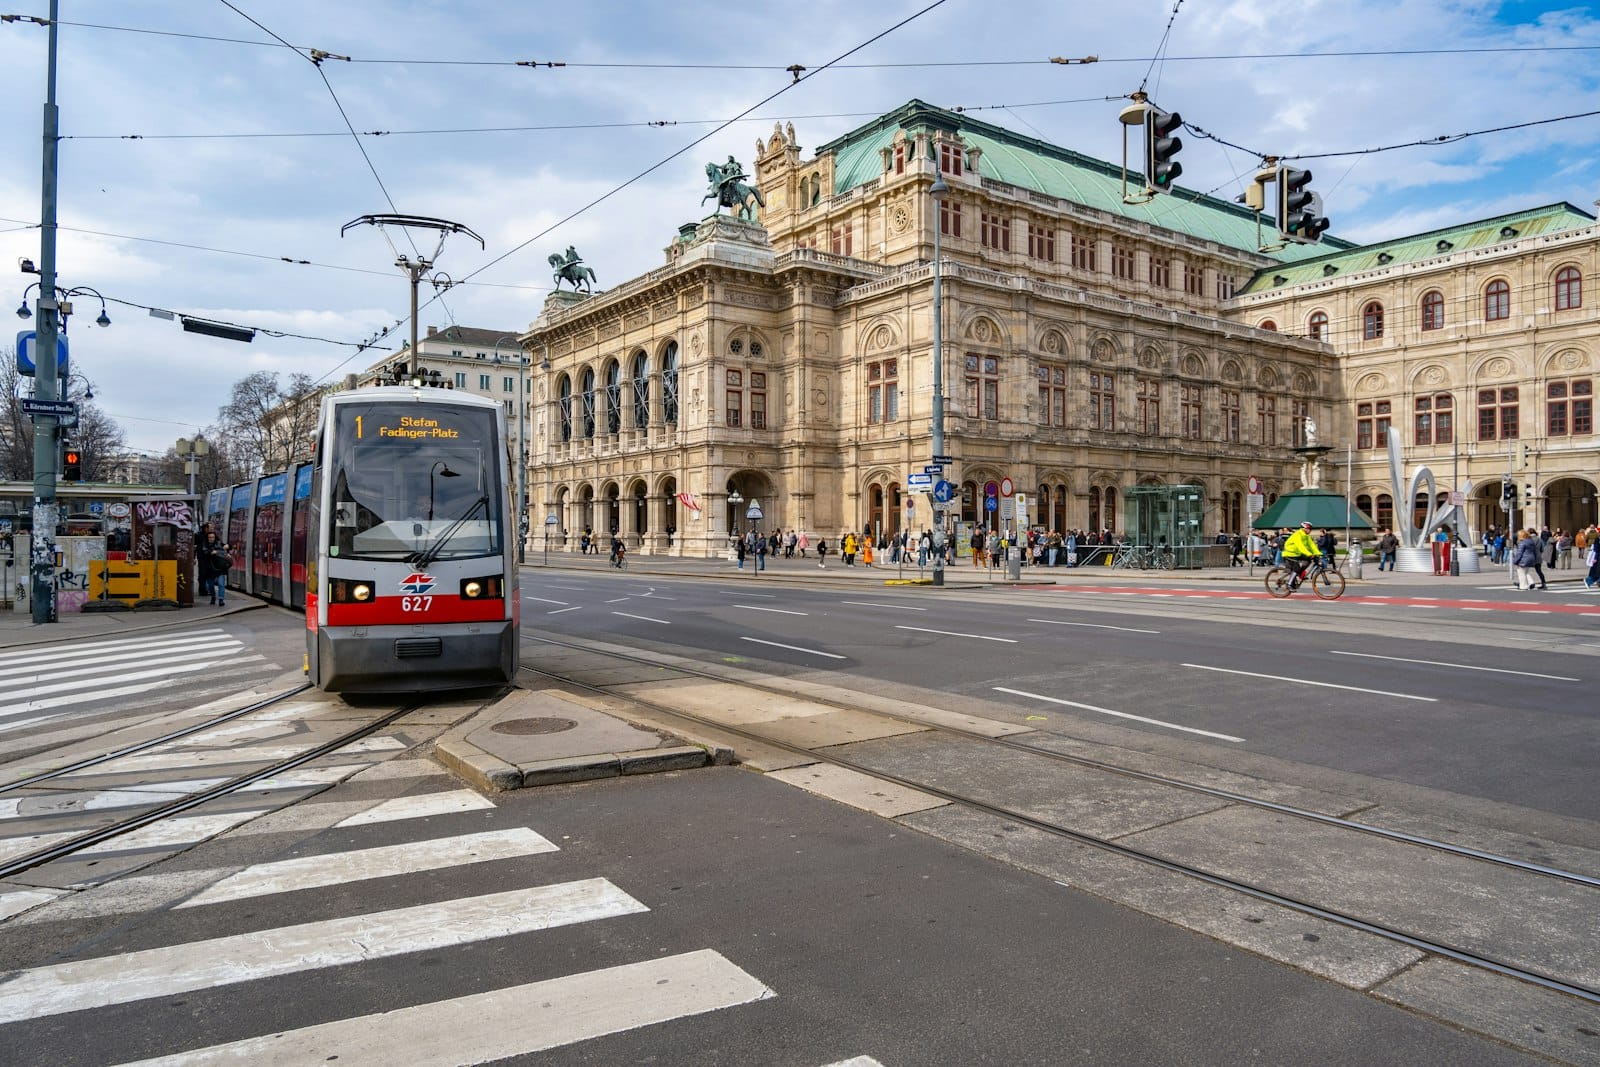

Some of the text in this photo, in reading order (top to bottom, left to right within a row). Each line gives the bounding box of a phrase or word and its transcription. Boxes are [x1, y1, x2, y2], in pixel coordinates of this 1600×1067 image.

[355, 415, 363, 439] 1
[400, 416, 438, 427] Stefan
[380, 426, 459, 438] Fadinger-Platz
[402, 596, 433, 612] 627
